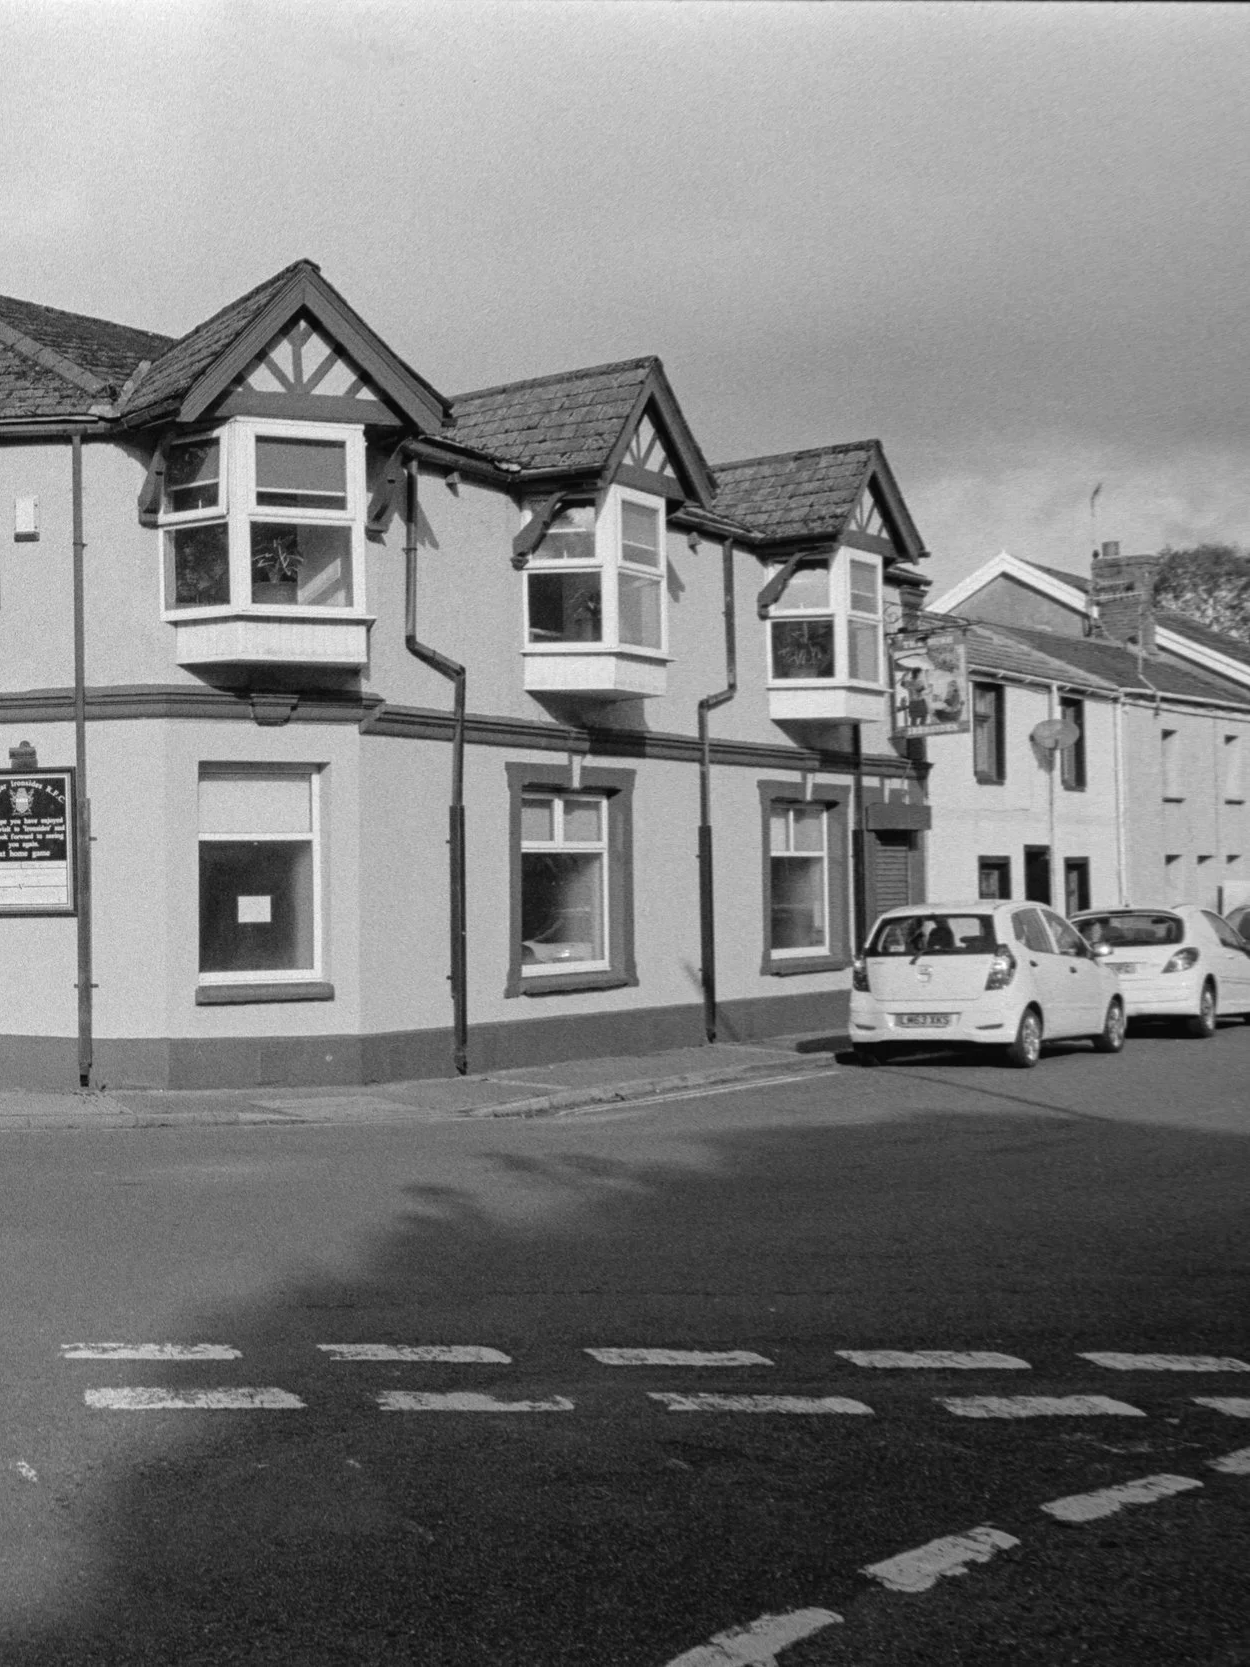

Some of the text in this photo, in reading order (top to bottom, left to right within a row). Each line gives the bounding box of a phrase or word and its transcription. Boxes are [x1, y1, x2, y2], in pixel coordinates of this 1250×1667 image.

[10, 780, 43, 790] Ironsides
[10, 819, 21, 827] you
[41, 817, 63, 826] enjoyed
[11, 833, 34, 841] forward
[46, 833, 64, 841] seeing
[9, 849, 28, 858] home
[32, 851, 51, 859] game
